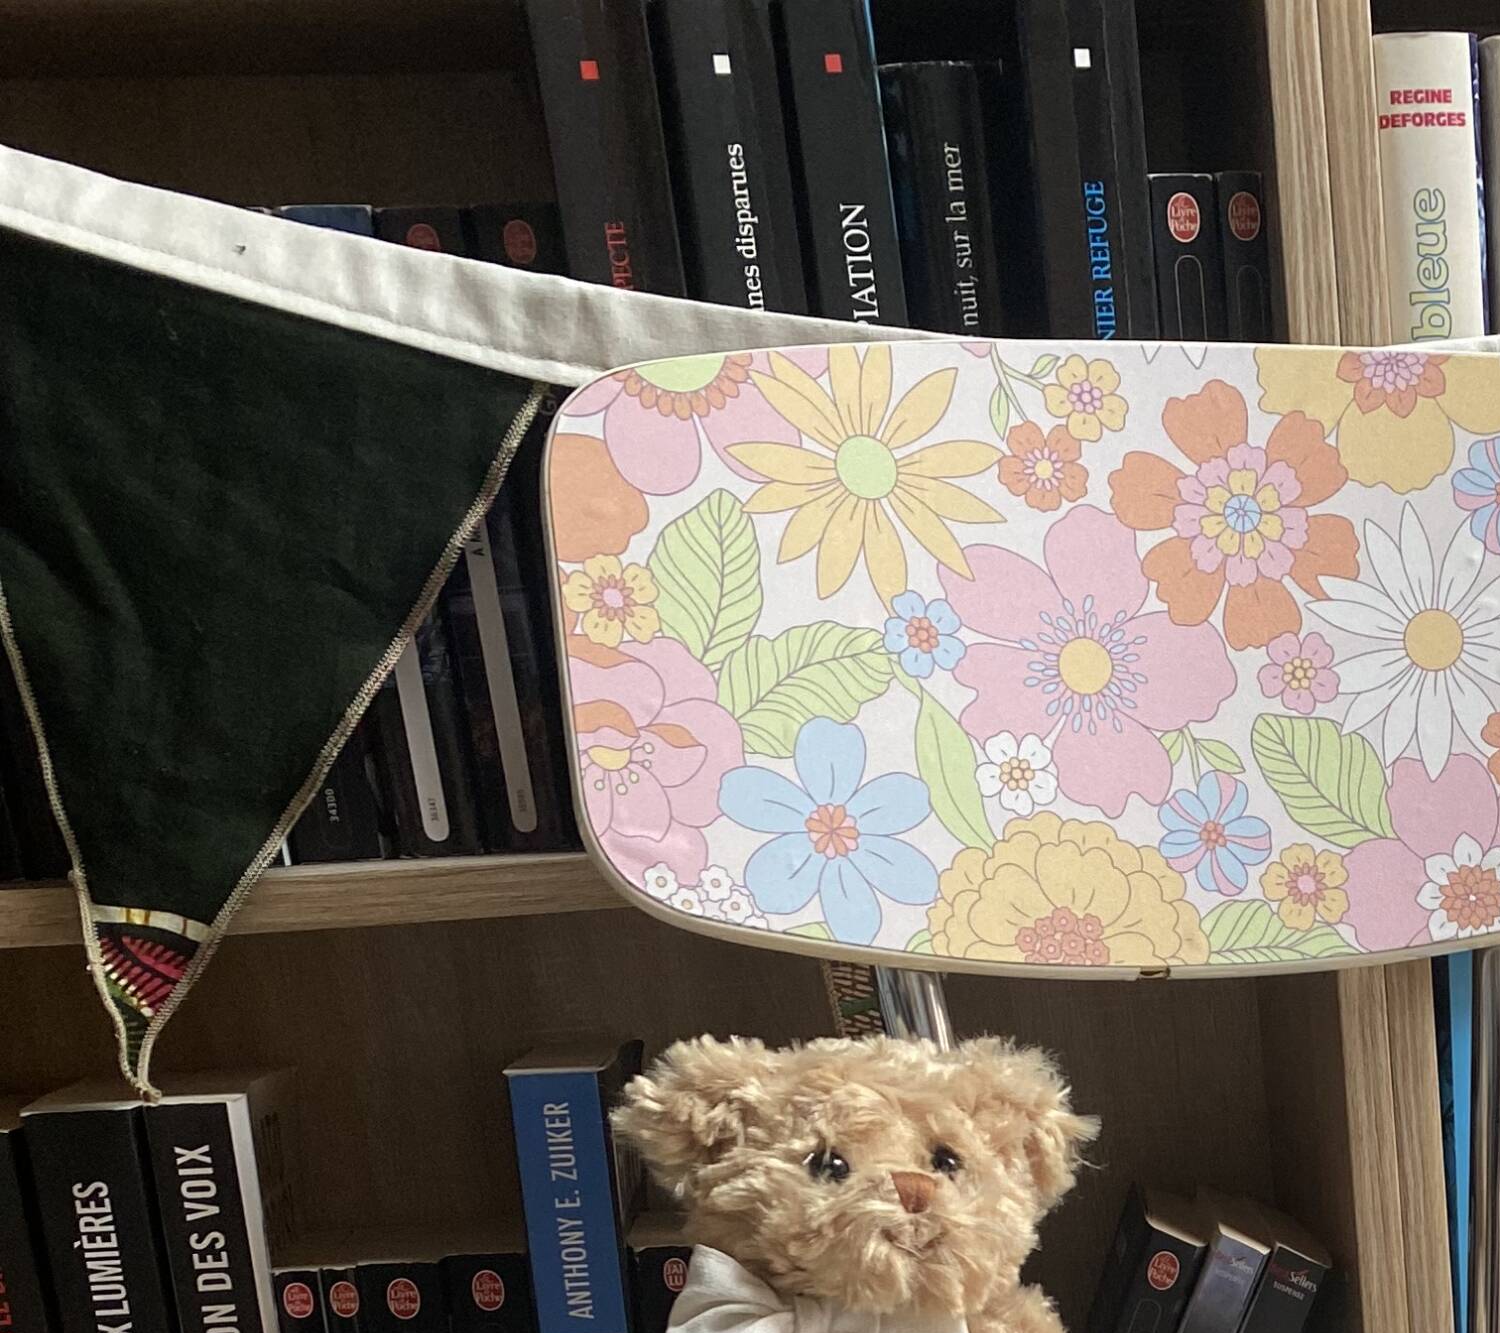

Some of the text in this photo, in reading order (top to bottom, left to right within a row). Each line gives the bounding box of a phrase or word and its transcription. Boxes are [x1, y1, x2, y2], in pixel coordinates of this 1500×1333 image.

[1379, 112, 1467, 129] DEFORGES
[1390, 88, 1452, 105] REGINE
[944, 142, 964, 192] mer
[728, 143, 759, 259] disparues
[946, 201, 968, 223] la
[1083, 181, 1112, 281] REFUGE
[954, 231, 973, 268] sur
[174, 1144, 221, 1222] VOIX
[543, 1102, 595, 1319] ANTHONY ZUIKER
[72, 1180, 132, 1317] LUMIÈRES
[189, 1230, 233, 1293] DES
